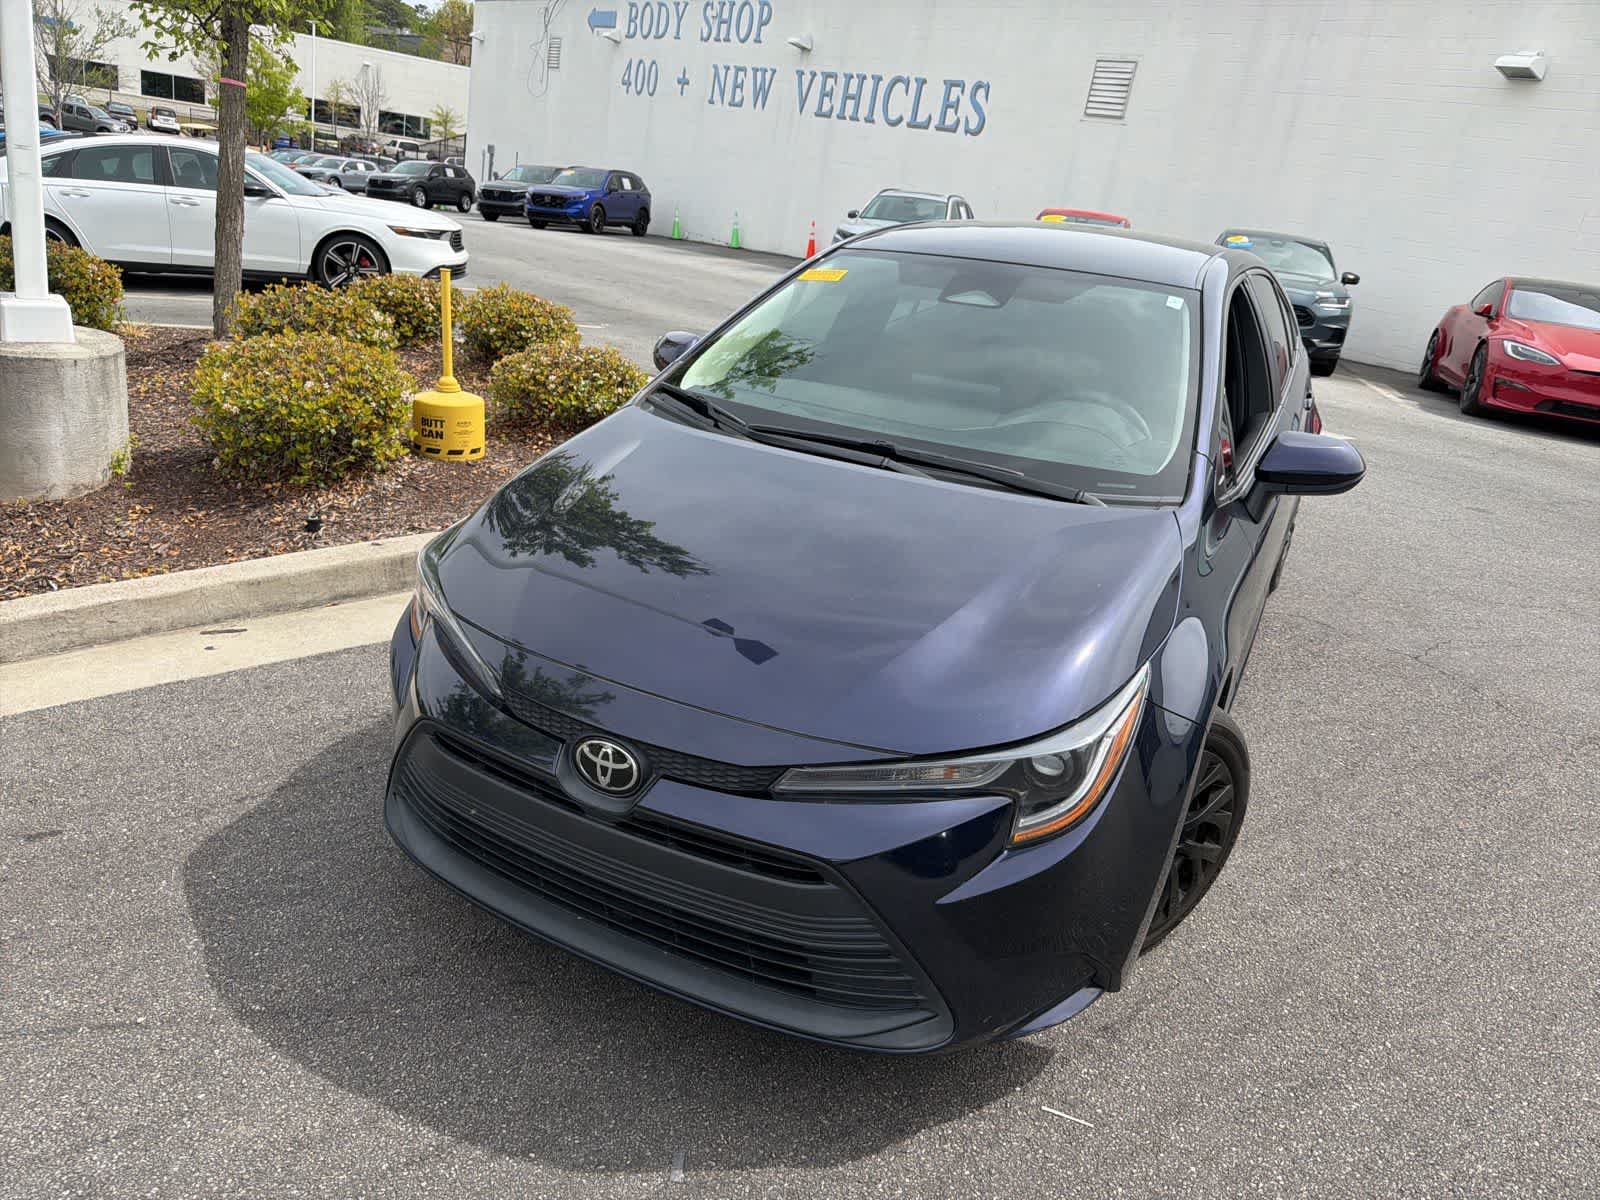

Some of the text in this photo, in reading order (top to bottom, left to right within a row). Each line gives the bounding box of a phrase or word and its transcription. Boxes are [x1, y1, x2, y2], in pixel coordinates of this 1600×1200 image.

[625, 0, 773, 43] BODY SHOP
[621, 58, 990, 136] 400 + NEW VEHICLES
[421, 416, 446, 428] BUTT
[421, 428, 444, 439] CAN
